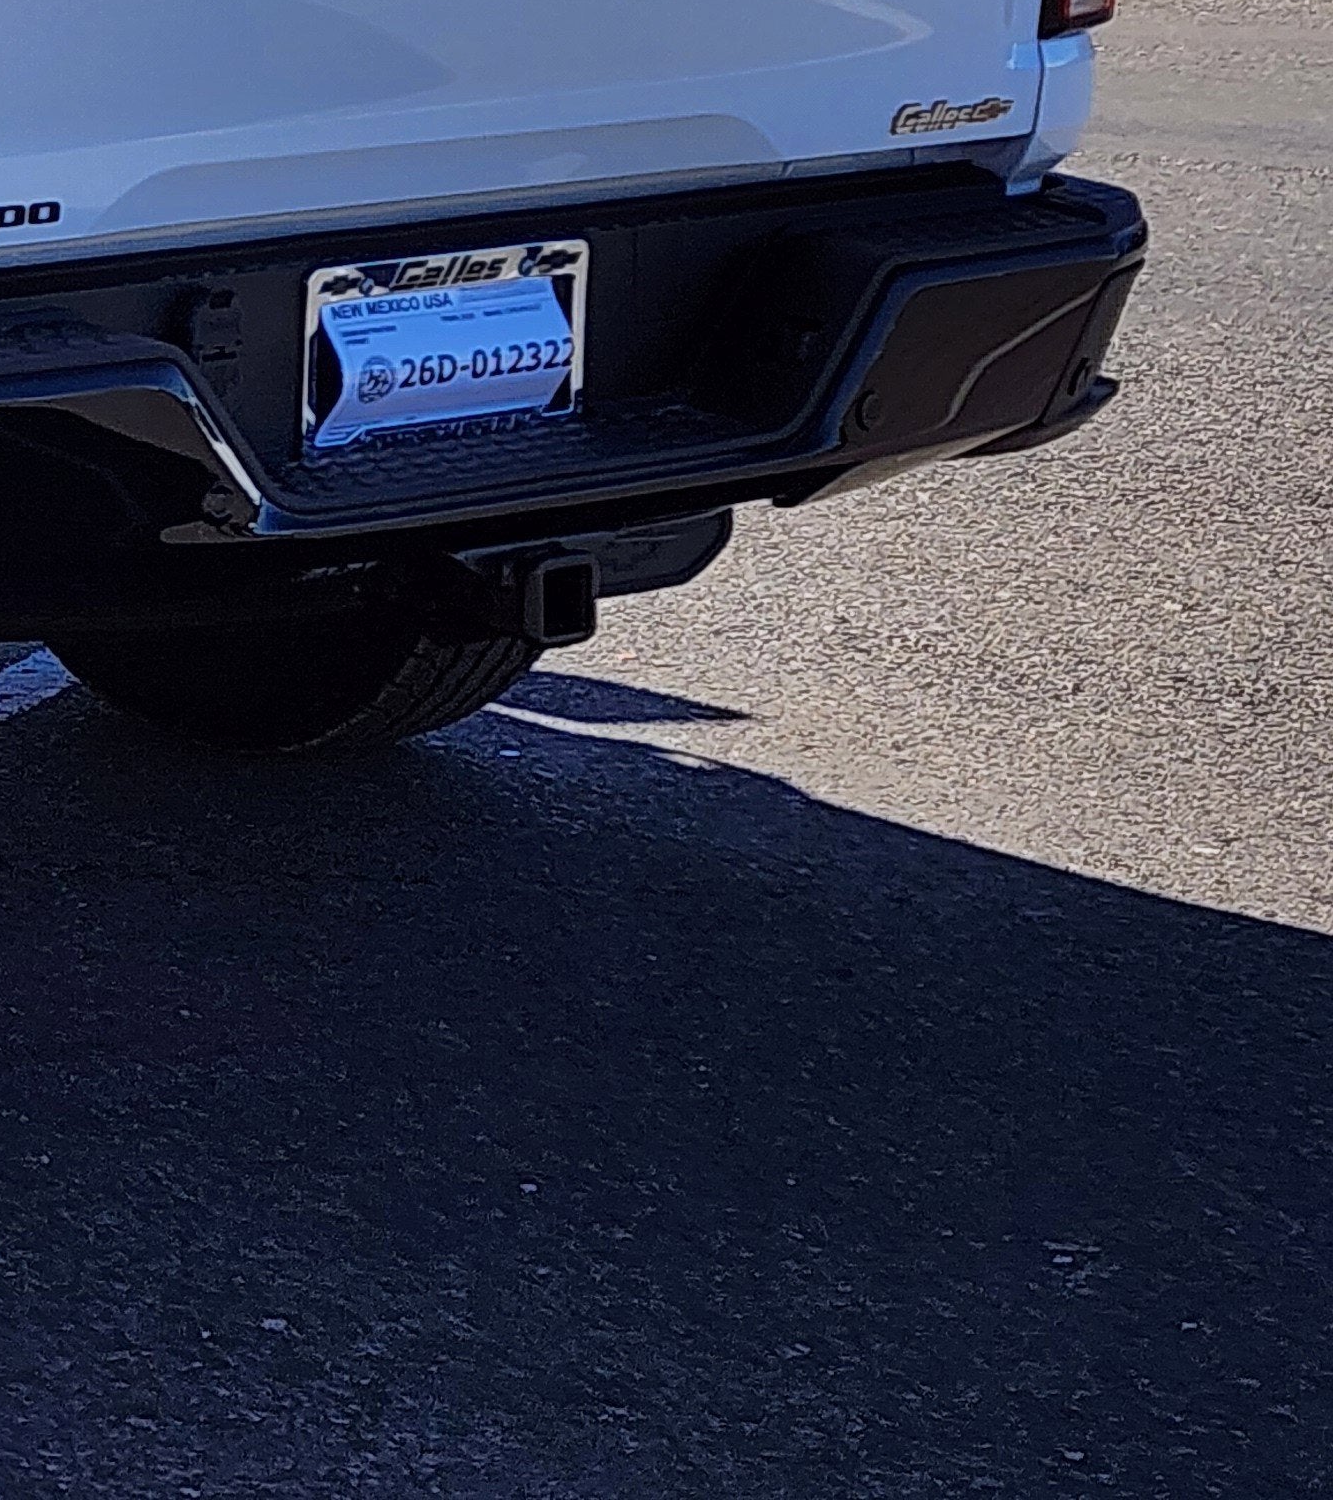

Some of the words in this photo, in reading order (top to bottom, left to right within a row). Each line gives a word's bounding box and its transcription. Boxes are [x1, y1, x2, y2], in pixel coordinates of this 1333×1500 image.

[331, 303, 363, 321] NEW
[367, 296, 420, 316] MEXICO
[423, 292, 453, 310] USA
[398, 336, 575, 390] 26D-012322
